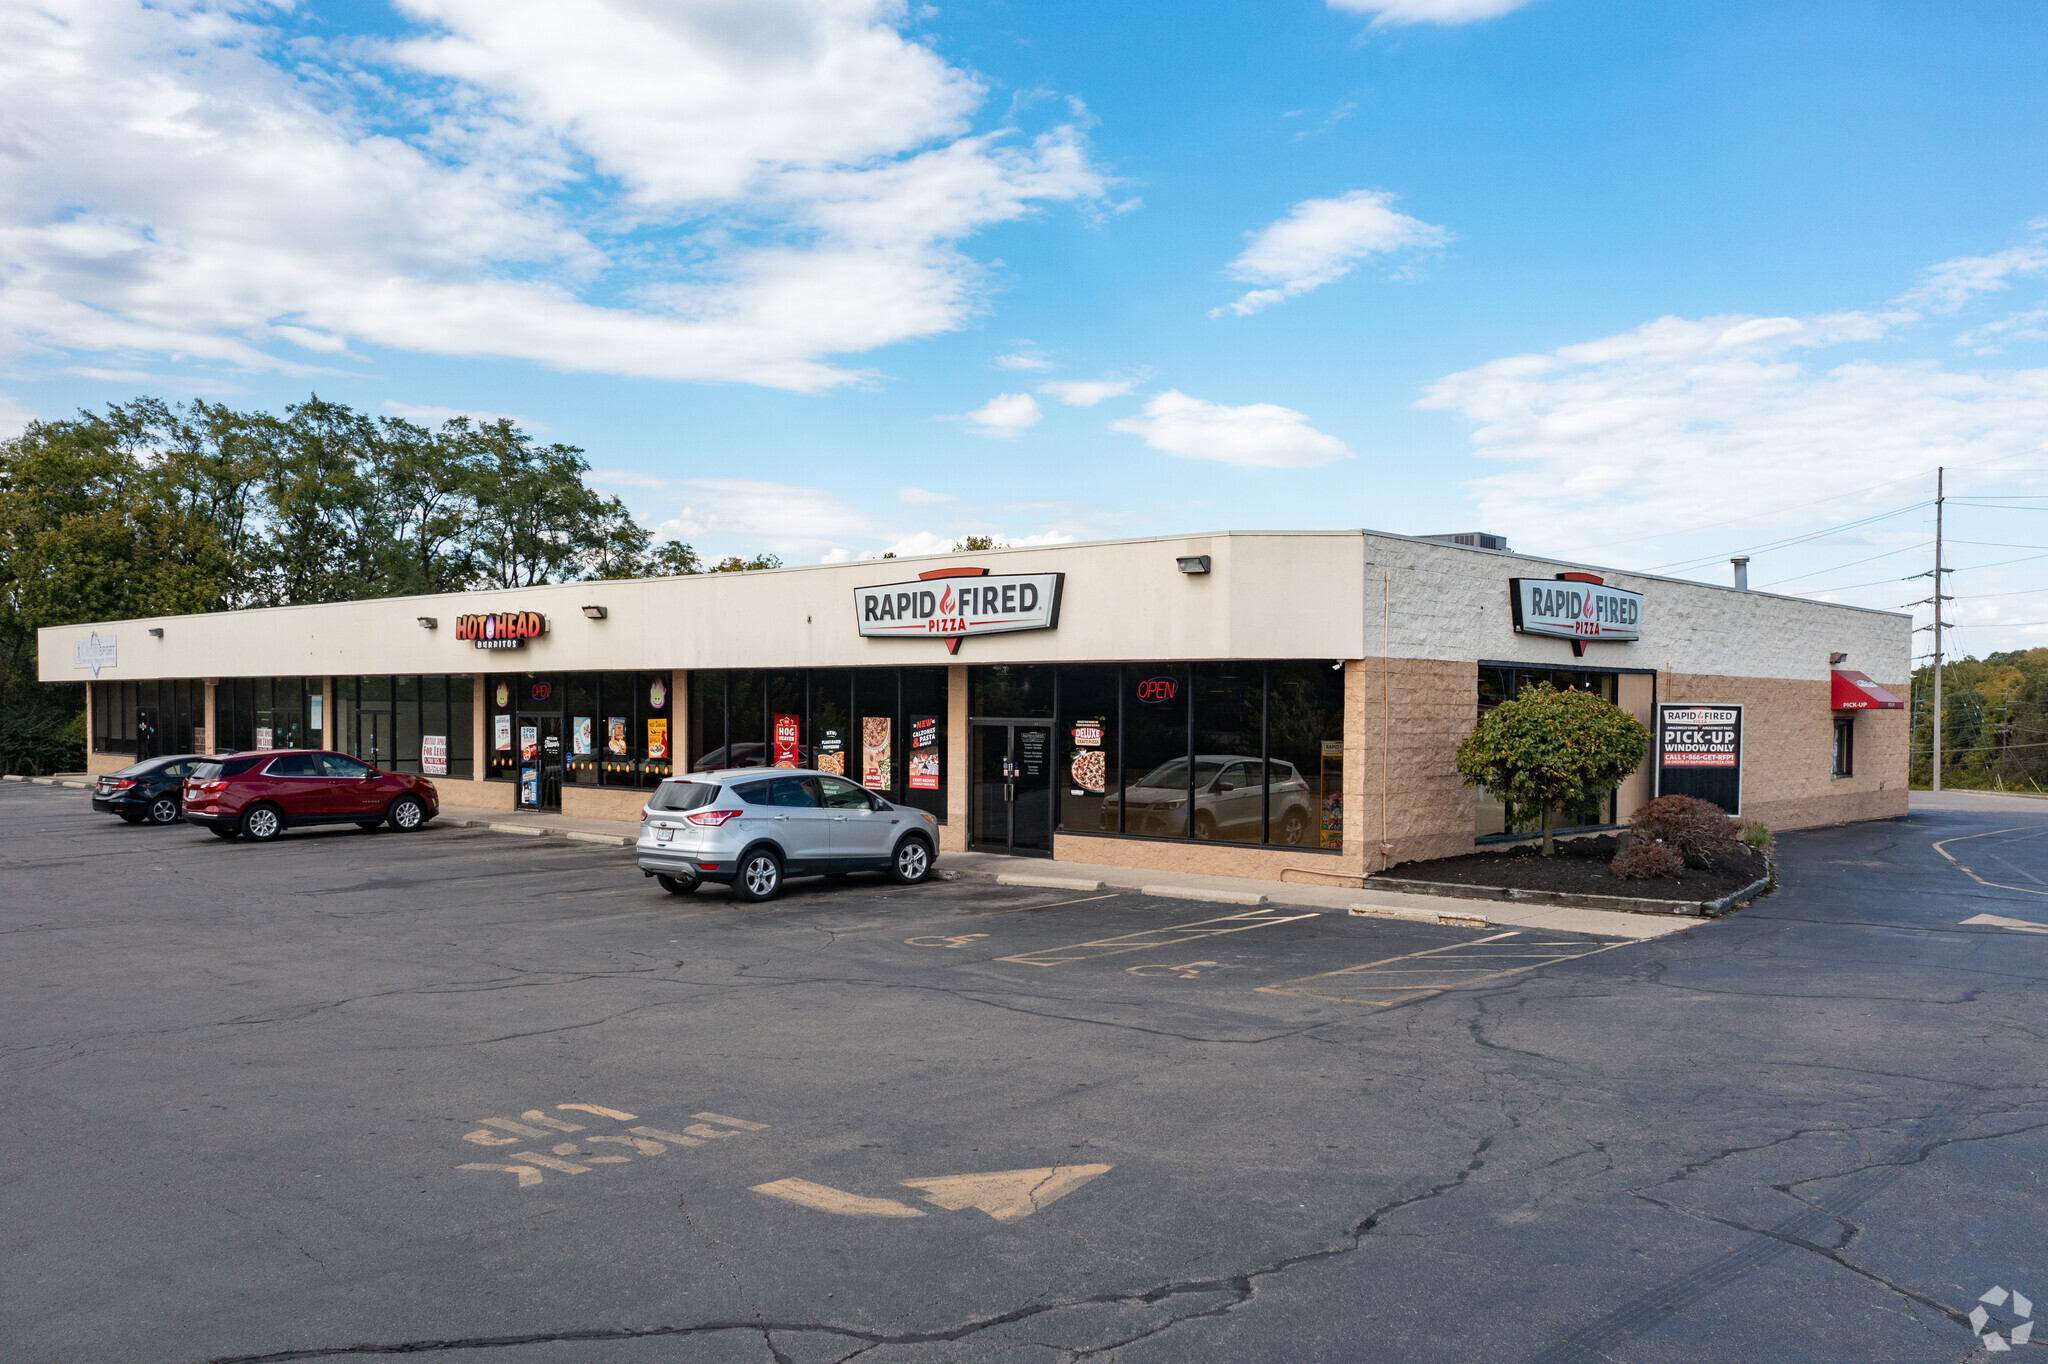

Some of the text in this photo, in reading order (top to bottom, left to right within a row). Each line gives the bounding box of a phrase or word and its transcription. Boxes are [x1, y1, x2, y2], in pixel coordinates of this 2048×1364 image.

[864, 583, 1038, 622] RAPID FIRED
[1532, 587, 1637, 625] RAPID FIRED
[456, 611, 541, 640] HOT HEAD
[928, 617, 966, 633] PIZZA
[1575, 621, 1600, 635] PIZZA
[477, 639, 517, 649] BURRITOS
[532, 684, 550, 699] OPEN
[1138, 681, 1175, 699] OPEN
[1668, 712, 1733, 720] RAPID FIRED
[916, 718, 933, 729] NEW
[778, 727, 795, 736] HOG
[1075, 728, 1101, 739] DELUXE
[1664, 731, 1735, 743] PICK-UP
[912, 733, 936, 748] & PASTA
[424, 746, 433, 756] FOR
[1664, 743, 1735, 752] WINDOW ONLY
